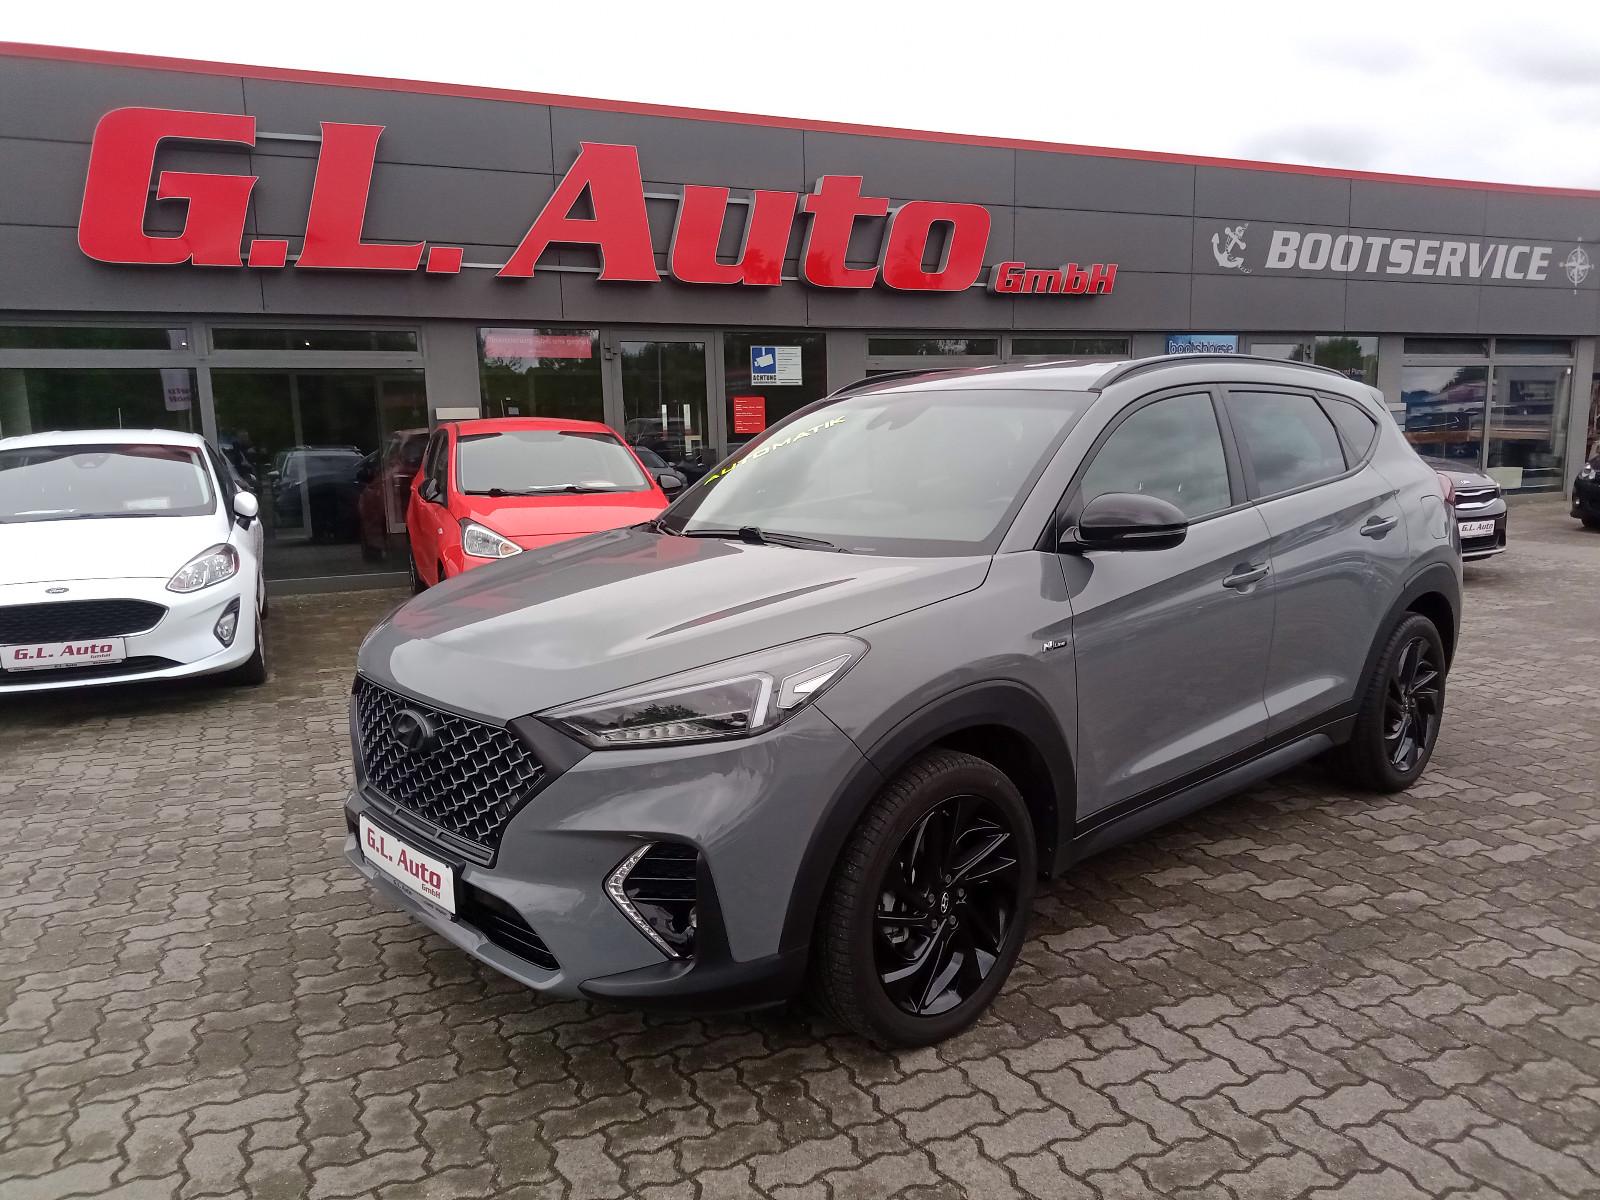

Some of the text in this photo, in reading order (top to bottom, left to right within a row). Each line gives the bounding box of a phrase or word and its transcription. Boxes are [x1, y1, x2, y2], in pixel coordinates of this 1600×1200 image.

[78, 106, 1118, 295] G.L. Auto GmbH
[1264, 230, 1553, 281] BOOTSERVICE
[1477, 523, 1494, 531] Auto
[14, 644, 113, 661] G.L. Auto
[367, 826, 393, 862] G.L.
[397, 848, 442, 890] Auto
[421, 883, 441, 900] GmbH
